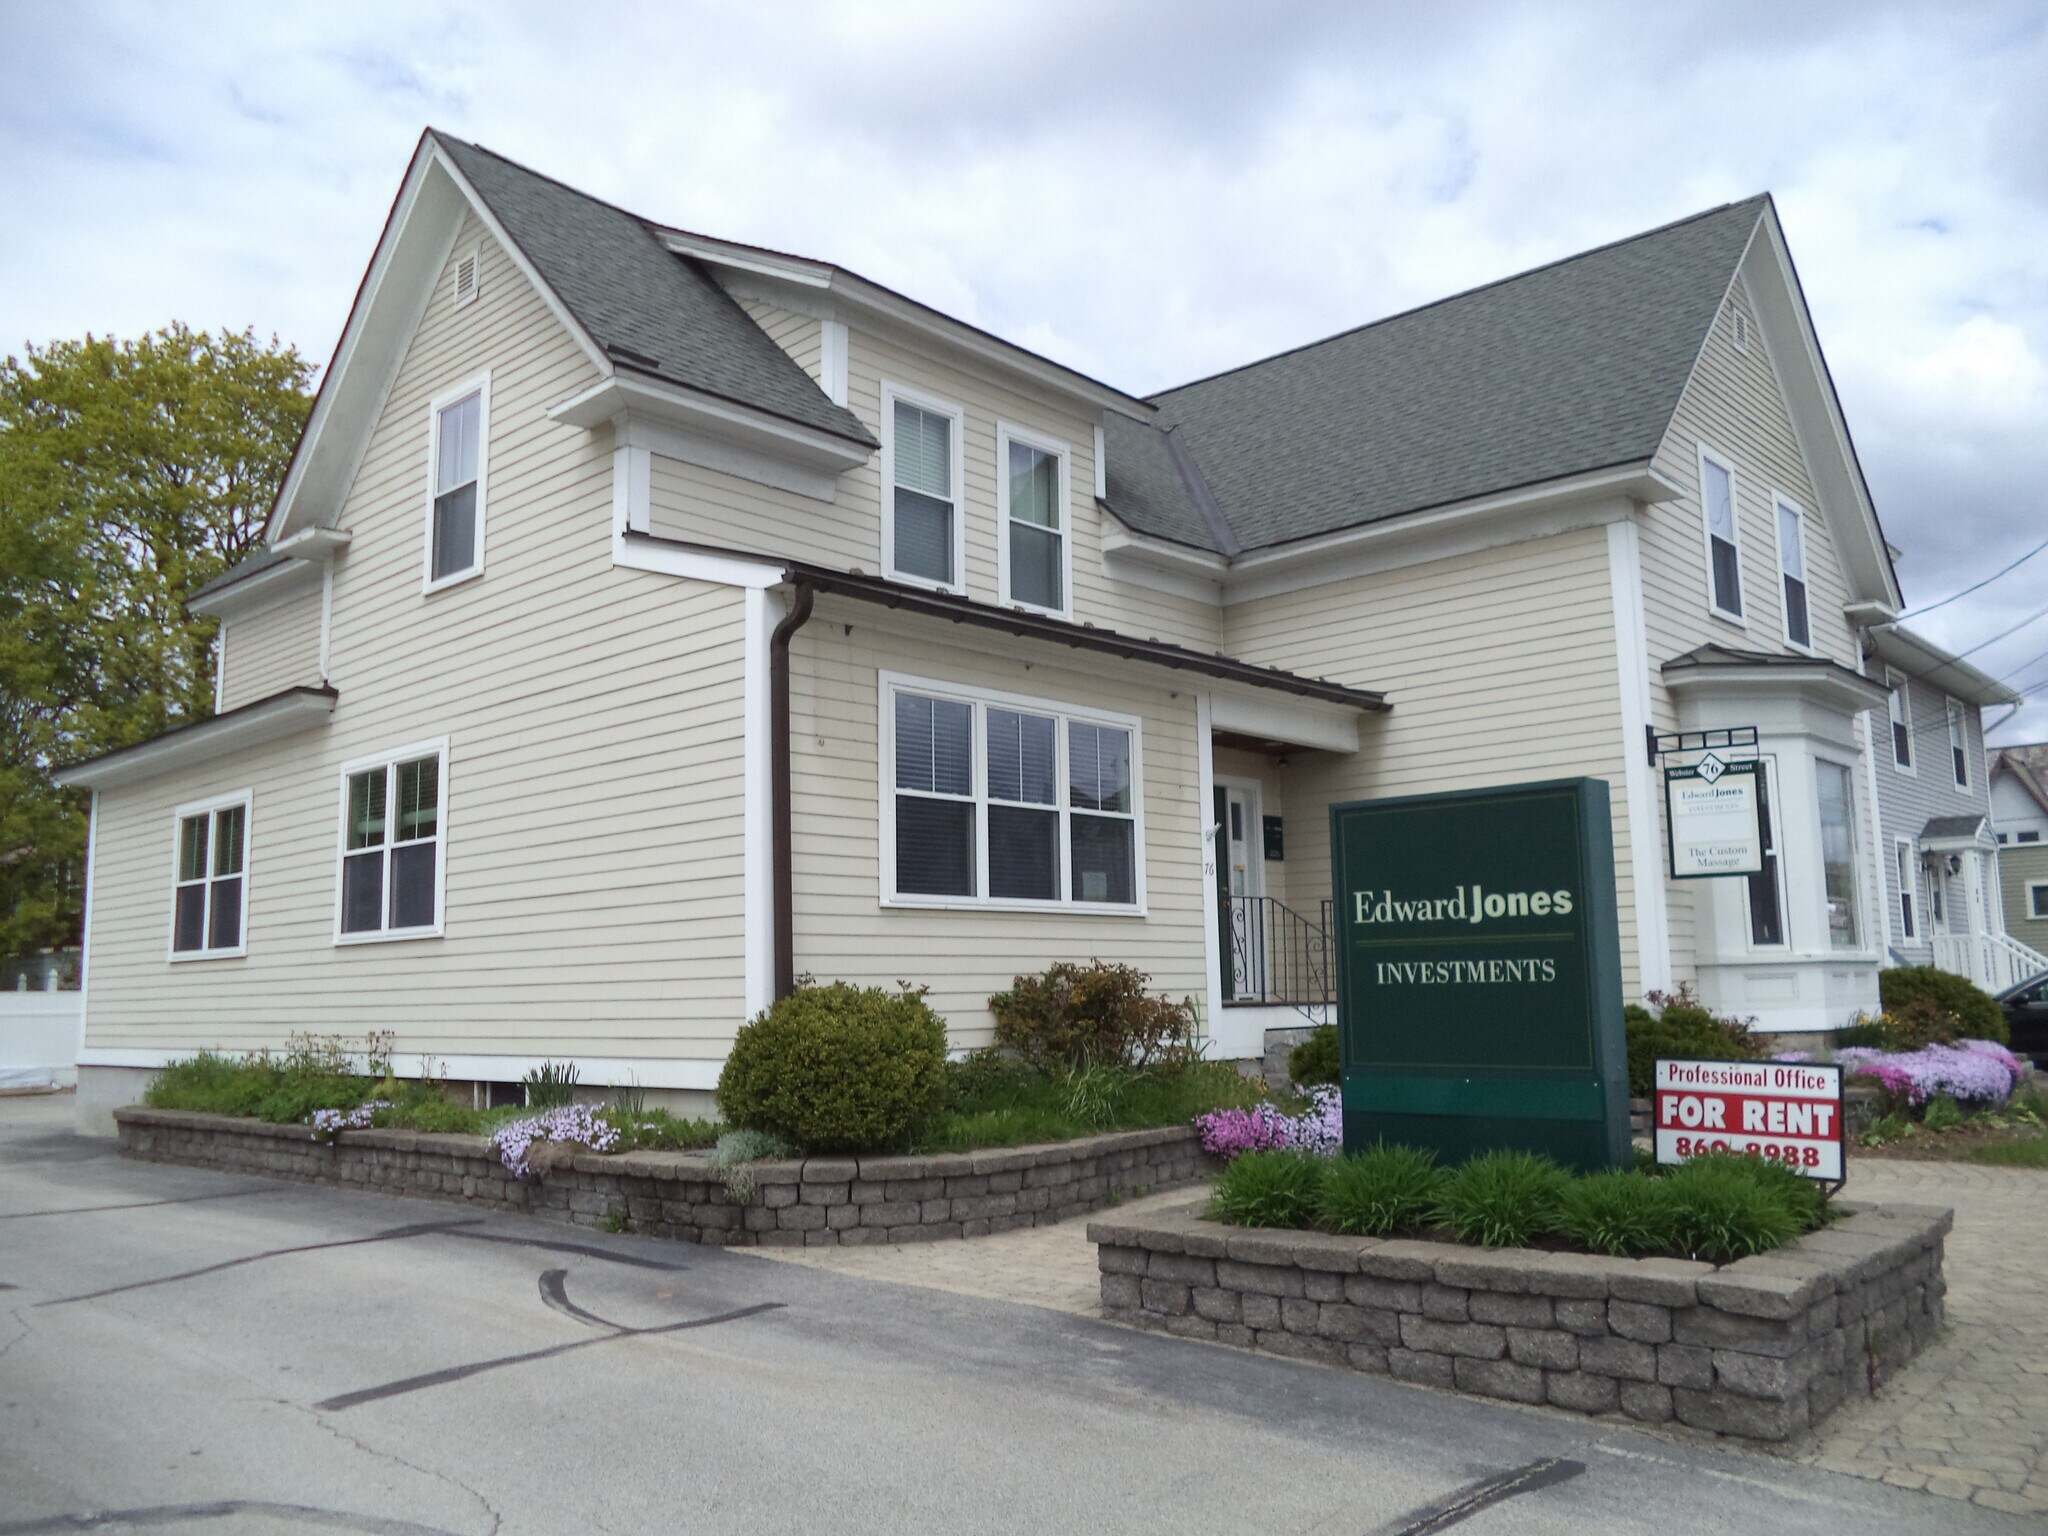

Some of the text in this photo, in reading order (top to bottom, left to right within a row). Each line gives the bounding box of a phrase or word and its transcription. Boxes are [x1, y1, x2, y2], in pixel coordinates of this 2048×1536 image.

[1669, 763, 1753, 777] Webster 76 Street
[1689, 847, 1747, 857] The Custom
[1204, 863, 1214, 876] 76
[1698, 857, 1740, 868] Massage
[1376, 959, 1556, 985] INVESTMENTS
[1669, 1064, 1826, 1089] Professional Office
[1662, 1095, 1834, 1136] FOR RENT
